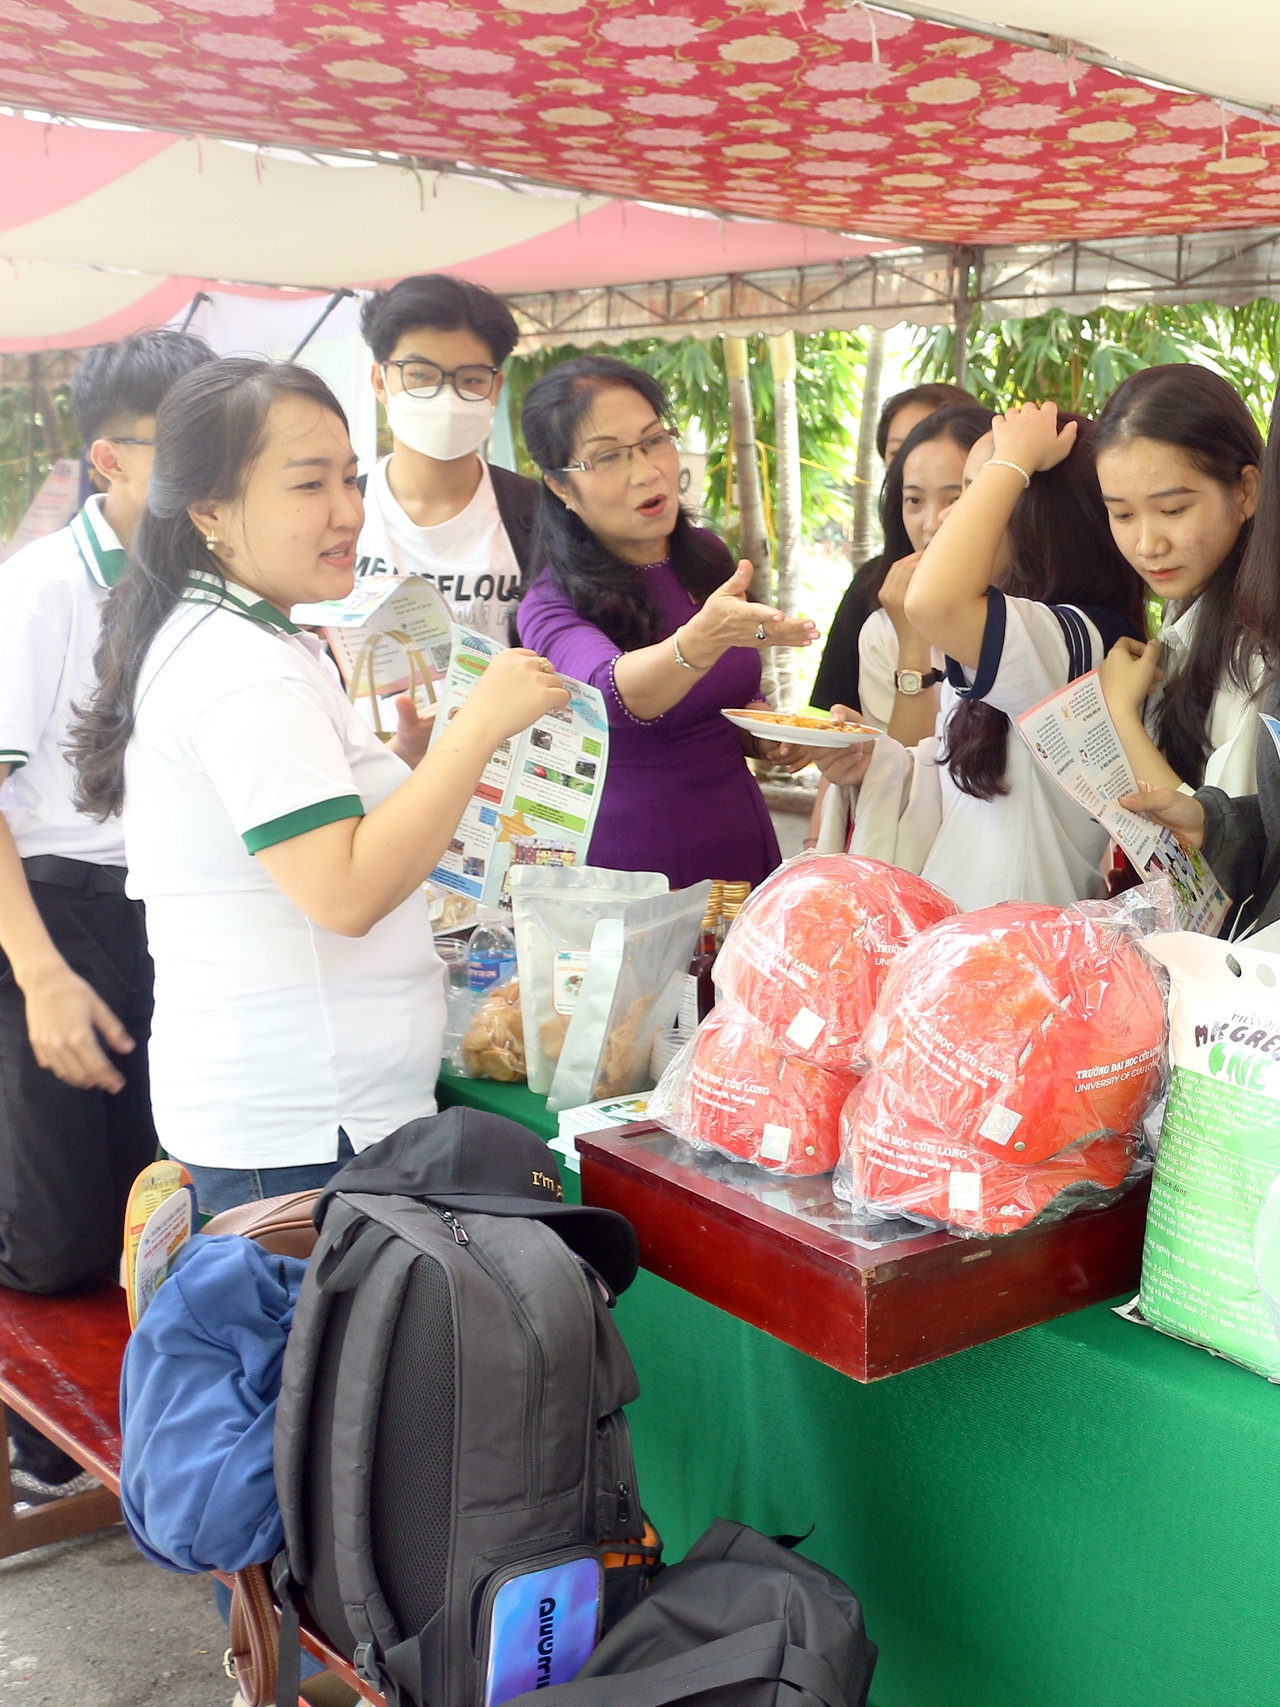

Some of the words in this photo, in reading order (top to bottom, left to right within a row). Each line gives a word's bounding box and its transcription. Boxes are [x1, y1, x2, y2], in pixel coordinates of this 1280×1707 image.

[793, 957, 819, 980] LONG
[933, 1032, 954, 1052] HỌC
[955, 1048, 978, 1067] CỬU
[978, 1062, 1009, 1083] LONG
[1076, 1065, 1109, 1079] TRƯỜNG
[1111, 1061, 1124, 1073] ĐẠI
[1125, 1056, 1139, 1069] HỌC
[709, 1074, 723, 1085] HỌC
[744, 1083, 770, 1095] LONG
[1074, 1075, 1120, 1093] UNIVERSITY
[1120, 1072, 1130, 1081] OF
[1195, 1086, 1210, 1097] Giúp
[891, 1136, 911, 1148] HỌC
[913, 1140, 935, 1154] CỬU
[937, 1147, 968, 1159] LONG
[531, 1170, 555, 1191] I'm
